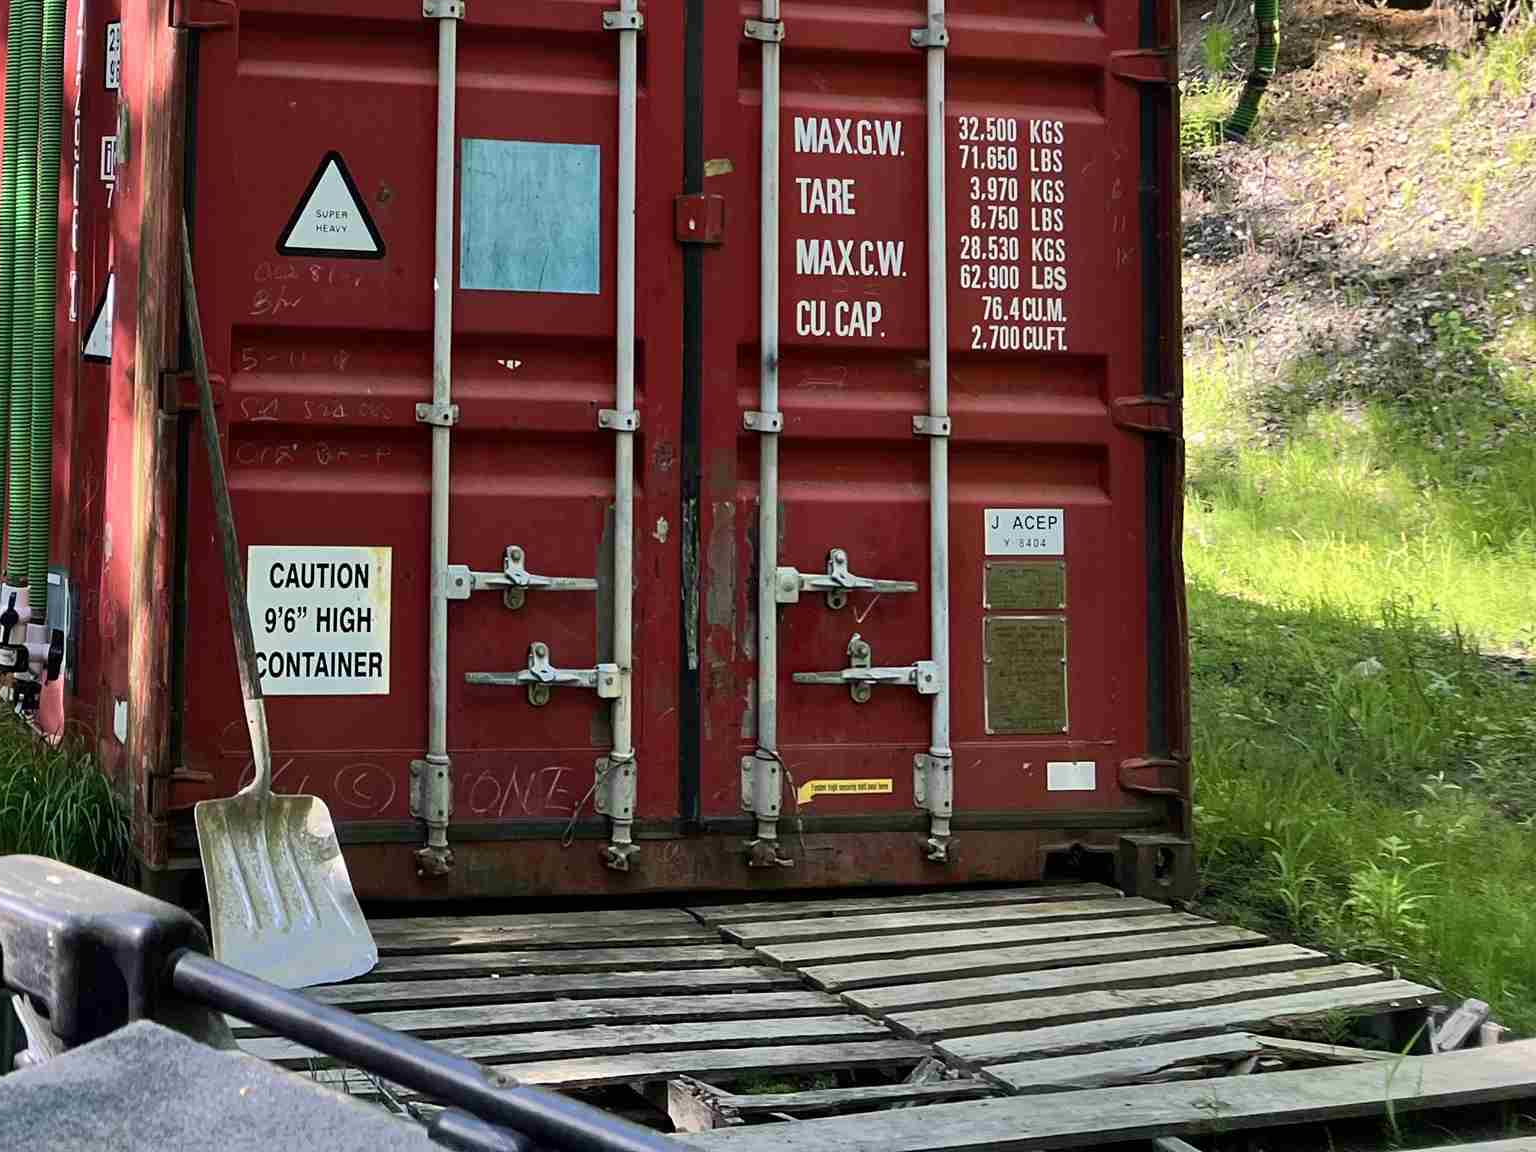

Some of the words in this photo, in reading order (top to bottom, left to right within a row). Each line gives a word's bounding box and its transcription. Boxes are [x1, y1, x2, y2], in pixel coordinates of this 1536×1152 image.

[959, 116, 1017, 142] 32,500
[1029, 119, 1065, 145] KGS
[959, 145, 1018, 171] 71,650
[1030, 147, 1064, 173] LBS
[795, 177, 856, 215] TARE
[970, 177, 1018, 202] 3,970
[1030, 179, 1065, 204] KGS
[315, 209, 348, 219] SUPER
[970, 206, 1018, 231] 8,750
[1031, 207, 1064, 232] LBS
[316, 224, 348, 234] HEAVY
[960, 236, 1020, 261] 28,530
[1031, 238, 1066, 263] KGS
[960, 265, 1020, 290] 62,900
[1032, 267, 1067, 292] LBS
[982, 296, 1020, 321] 76.4
[971, 325, 1020, 350] 2,700
[991, 515, 1000, 530] J
[1012, 515, 1058, 530] ACEP
[269, 562, 369, 589] CAUTION
[316, 607, 372, 634] HIGH
[255, 651, 384, 678] CONTAINER
